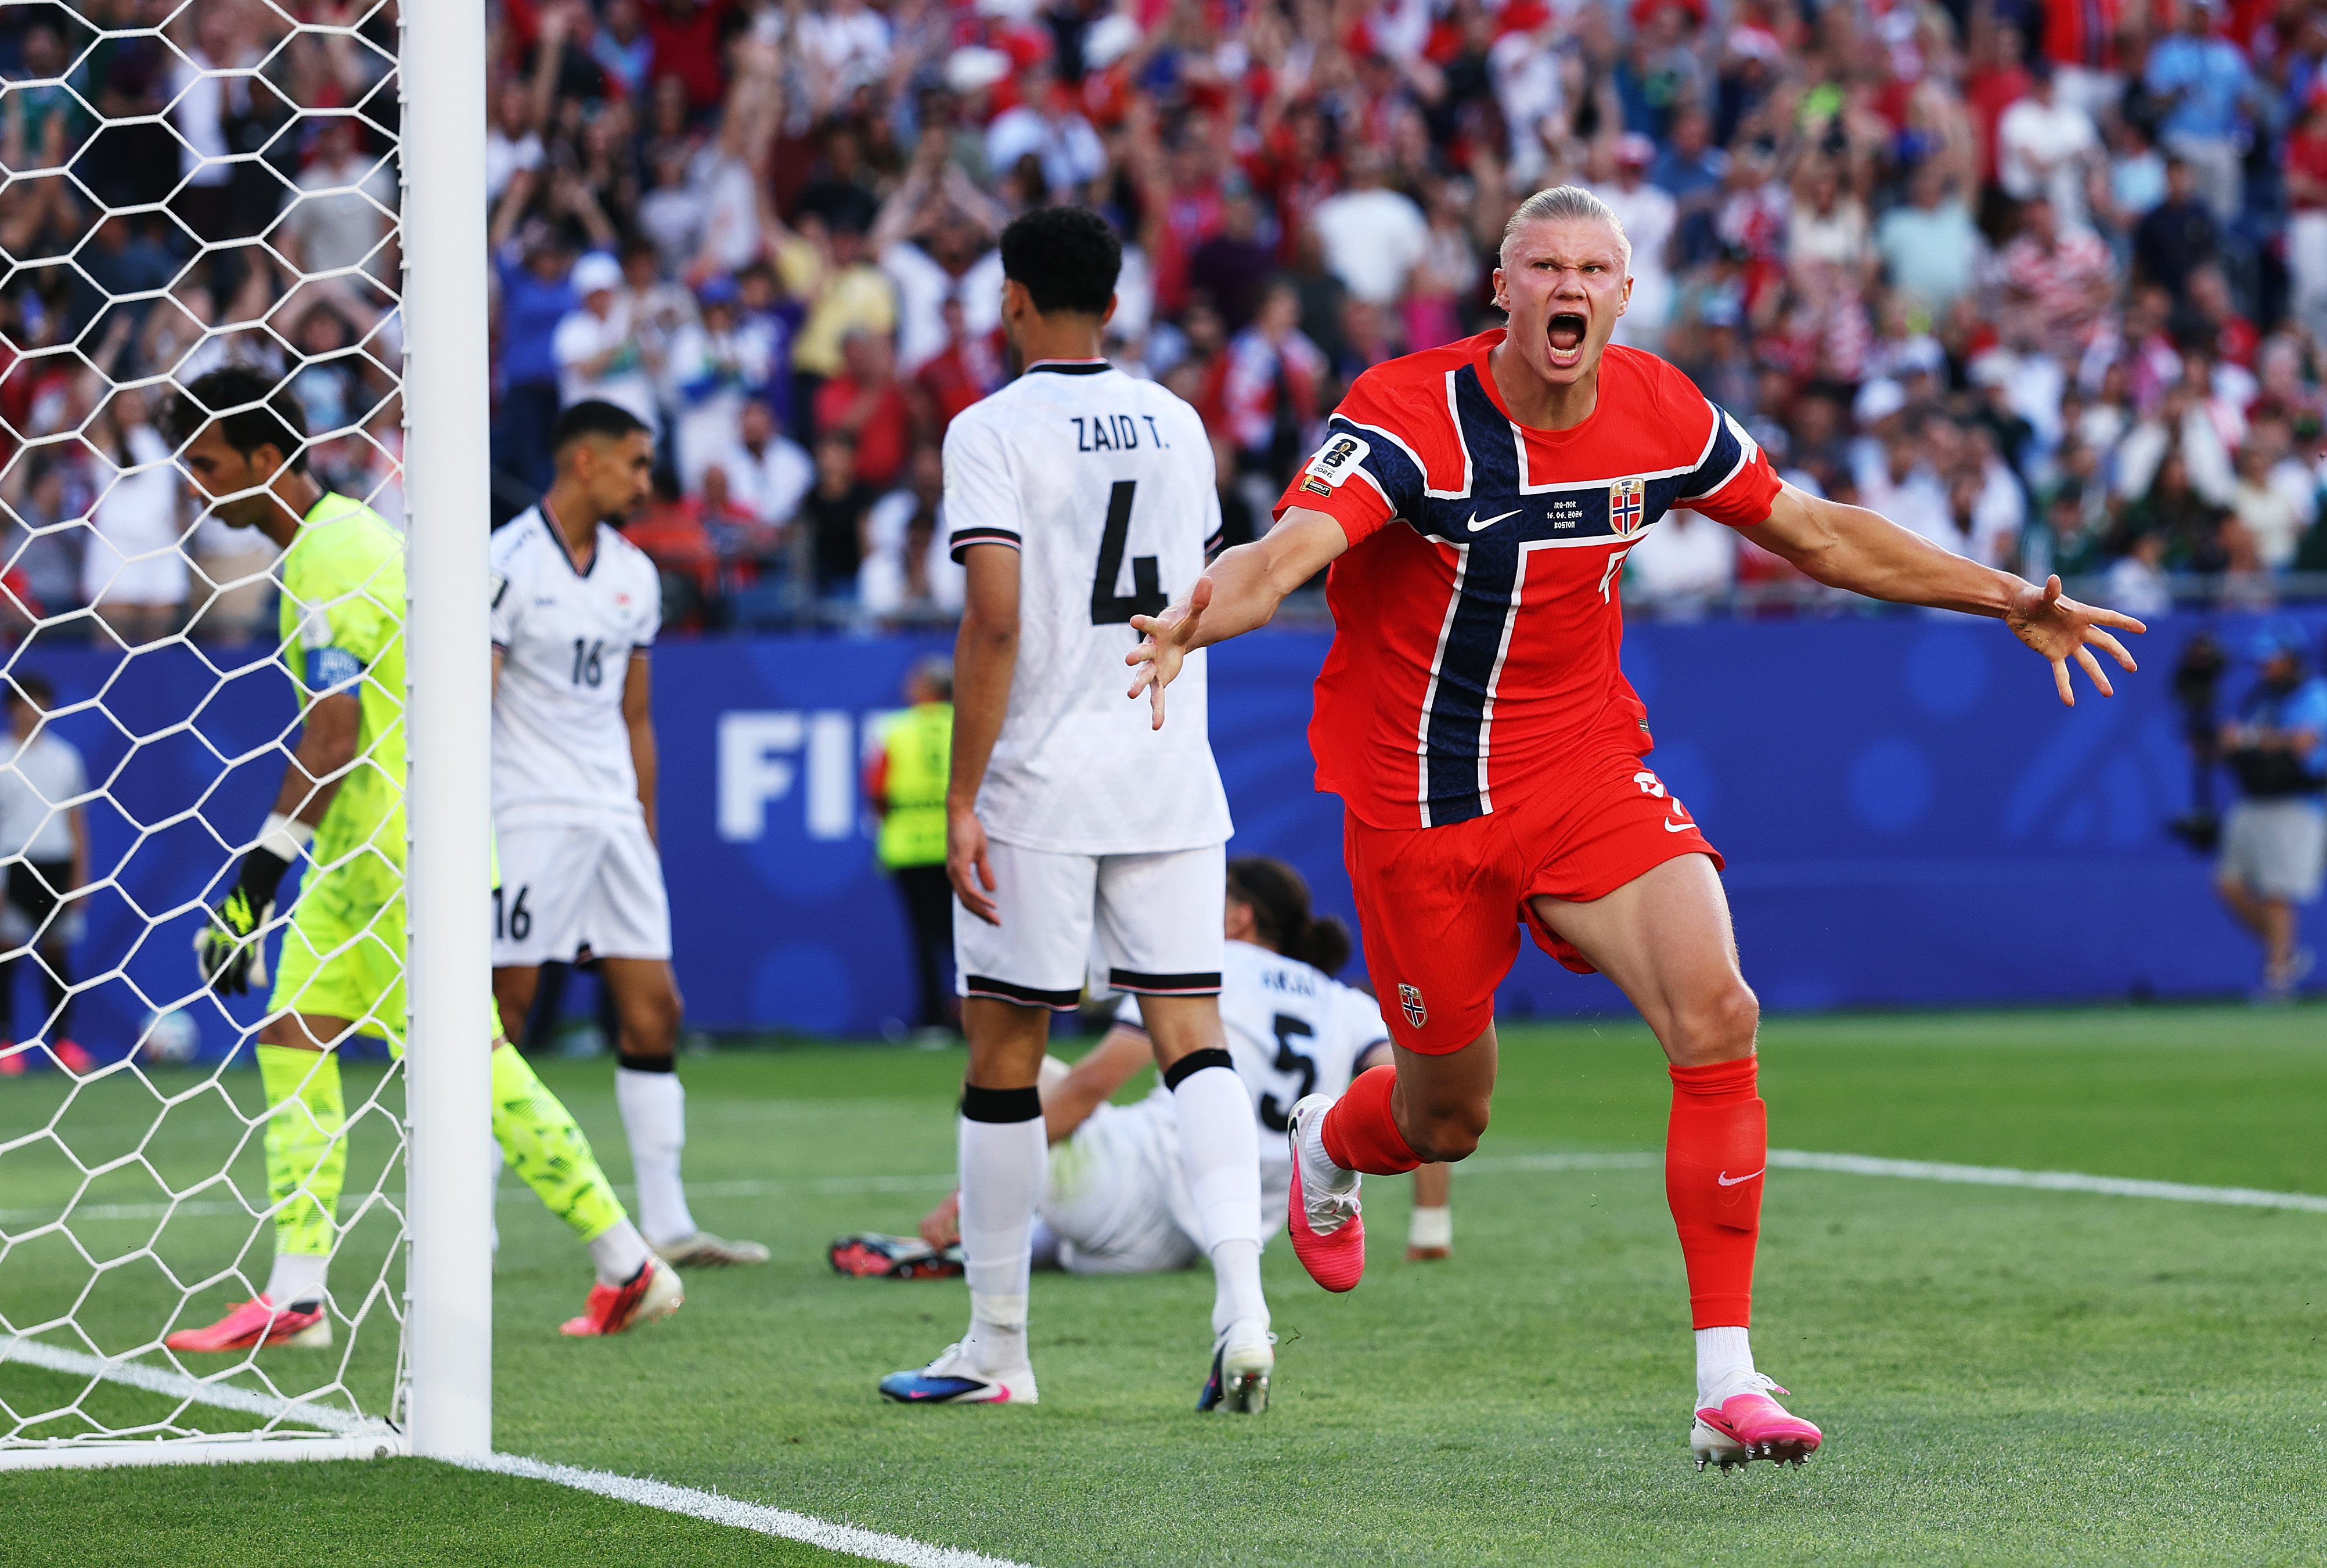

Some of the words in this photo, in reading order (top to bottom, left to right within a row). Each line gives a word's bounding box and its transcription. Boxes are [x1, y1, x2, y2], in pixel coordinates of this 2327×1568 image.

[1071, 414, 1137, 452] ZAID
[1143, 415, 1169, 449] T.
[1309, 481, 1330, 492] DEBUT
[1314, 466, 1333, 478] 2026
[1092, 480, 1169, 644] 4
[573, 638, 603, 688] 16
[491, 885, 531, 940] 16
[1261, 1014, 1316, 1131] 5
